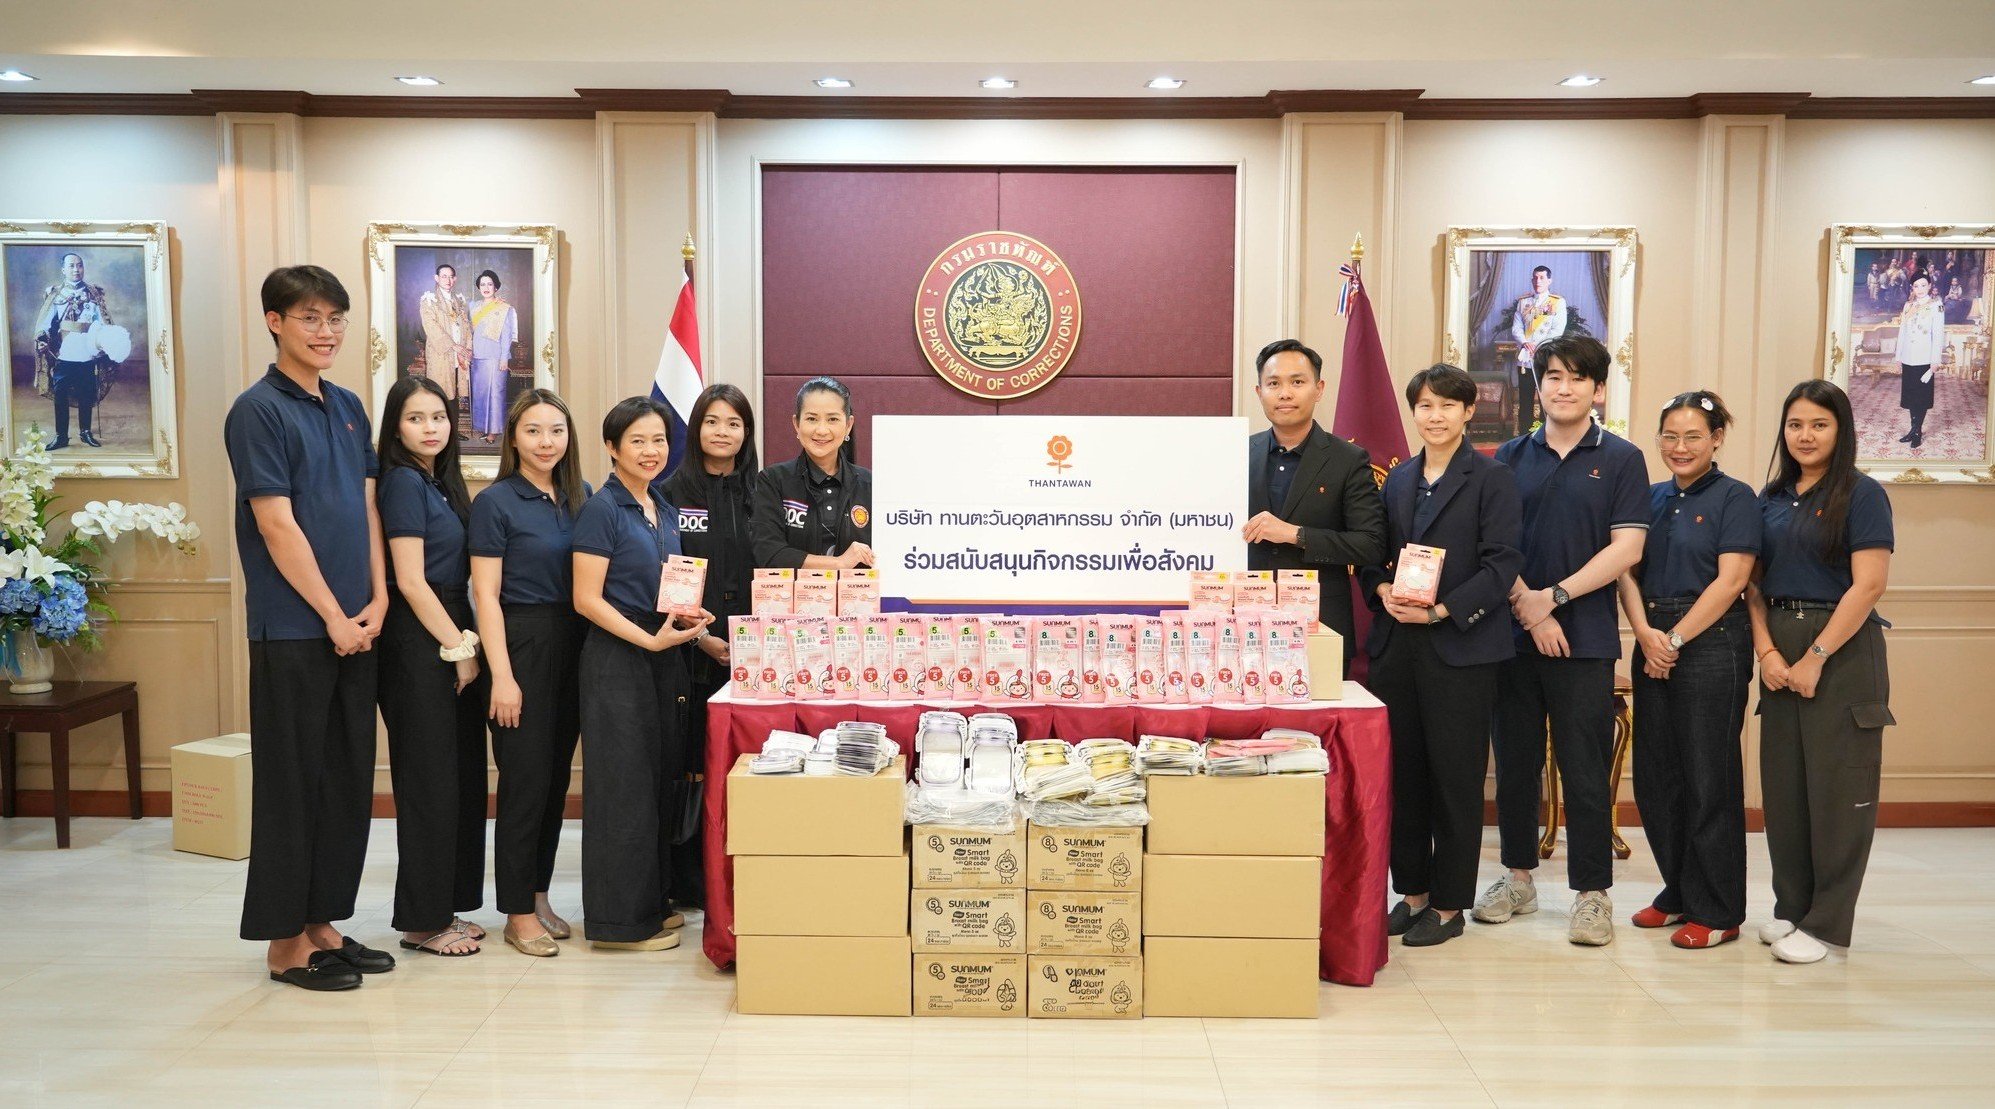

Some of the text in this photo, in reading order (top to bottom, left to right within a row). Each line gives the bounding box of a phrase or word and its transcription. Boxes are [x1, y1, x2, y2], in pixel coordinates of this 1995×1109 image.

[922, 305, 1073, 390] DEPARTMENT OF CORRECTIONS
[1029, 479, 1092, 488] THANTAWAN
[678, 514, 708, 530] DOC
[783, 507, 807, 525] OC
[886, 509, 1234, 530] บริษัท ทานตะวันอุตสาหกรรม จำกัด (มหาชน)
[904, 542, 1214, 577] ร่วมสนับสนุนกิจกรรมเพื่อสังคม
[932, 838, 937, 846] 5
